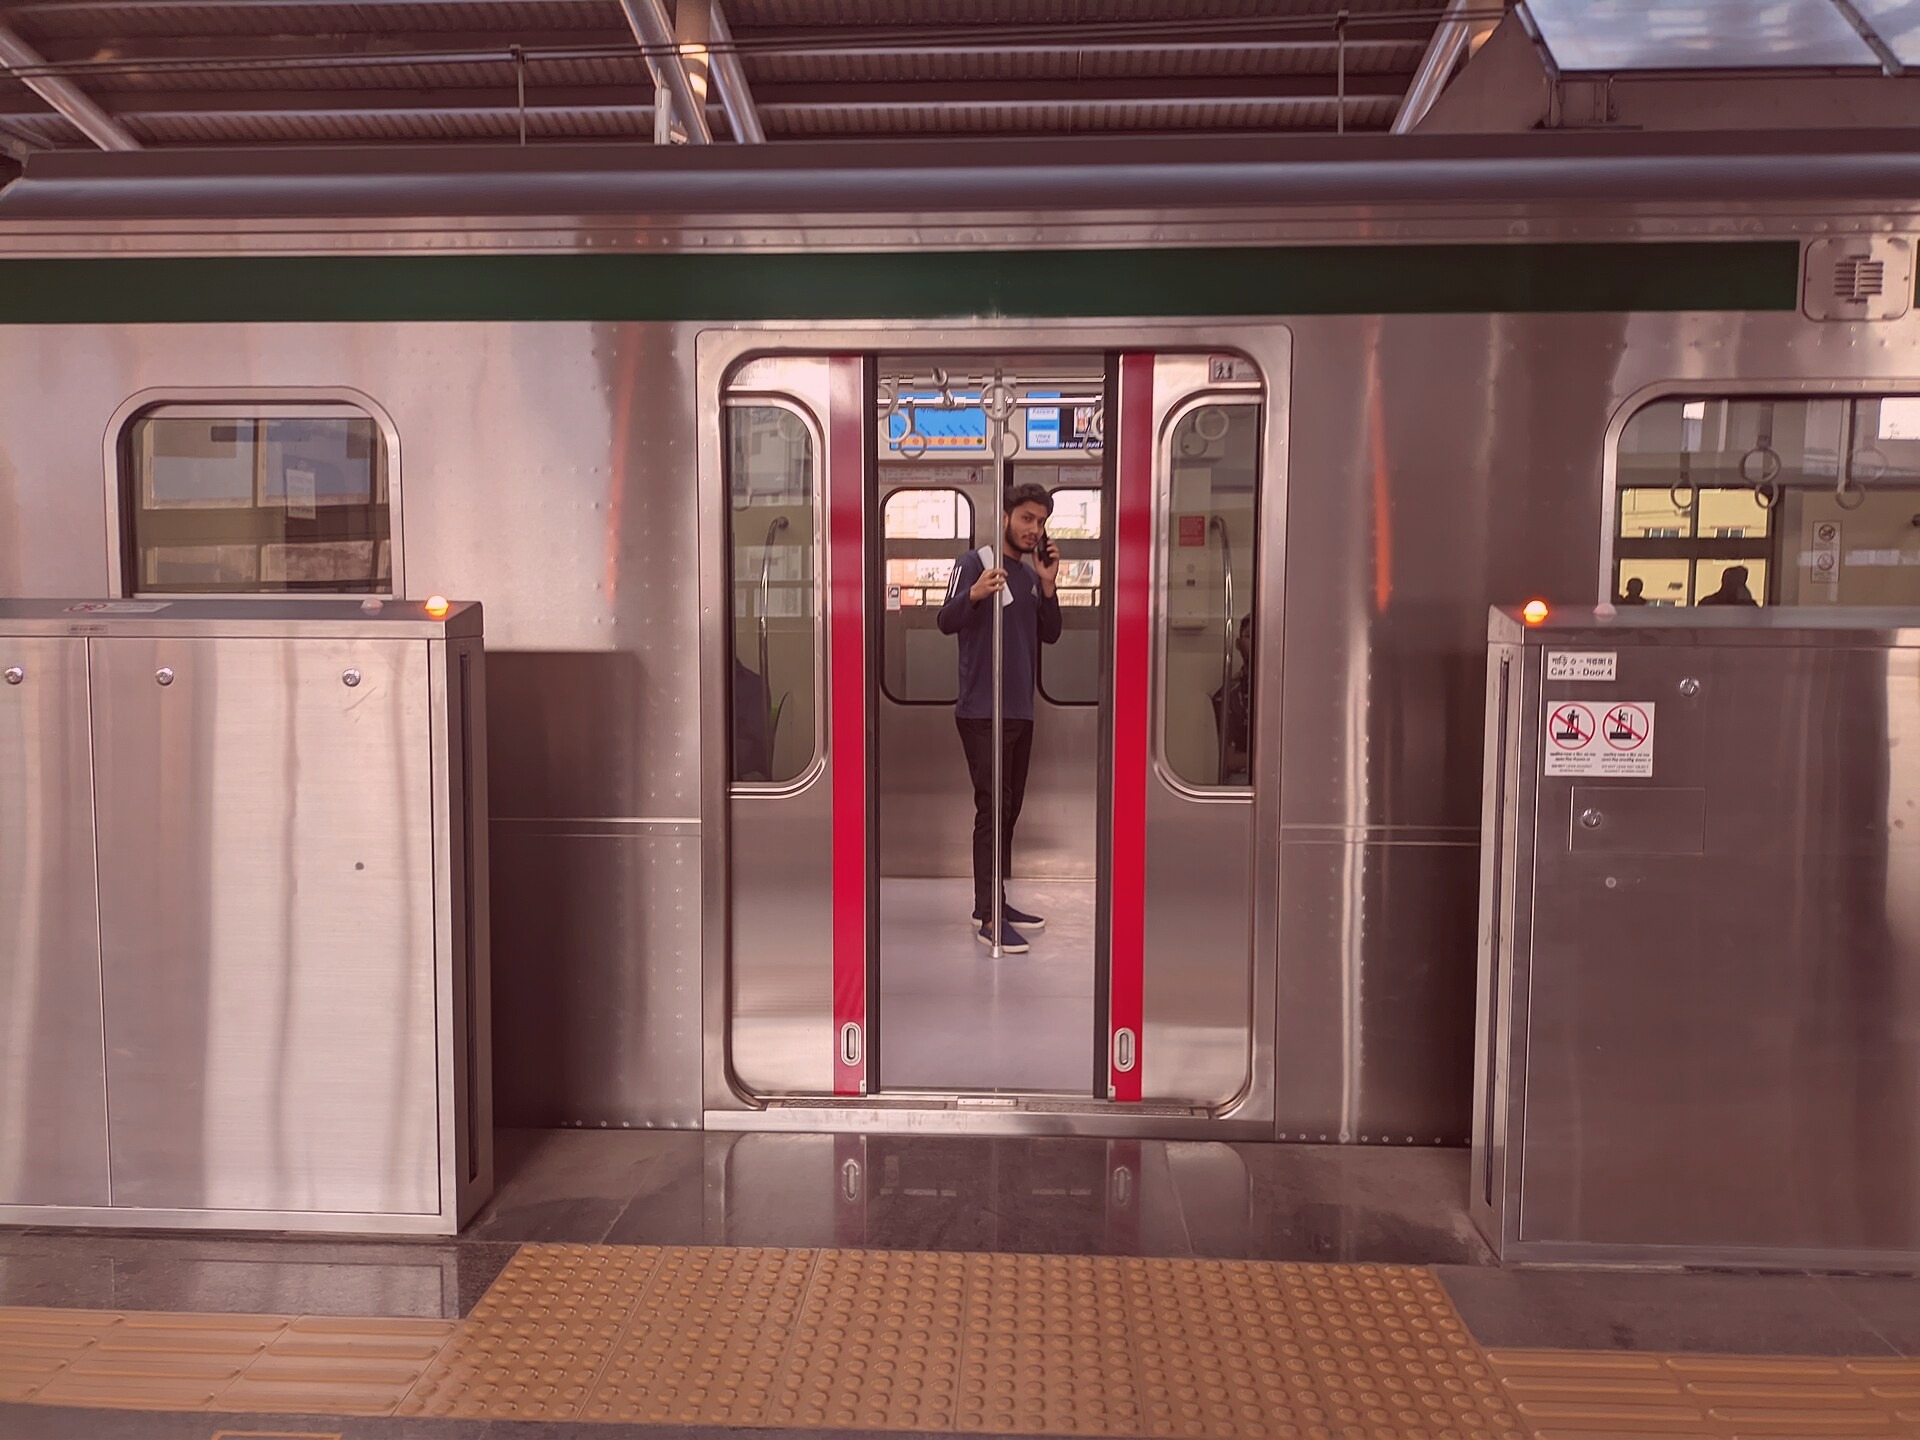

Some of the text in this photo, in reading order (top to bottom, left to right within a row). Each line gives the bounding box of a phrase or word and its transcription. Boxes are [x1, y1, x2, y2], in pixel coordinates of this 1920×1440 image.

[1551, 667, 1566, 675] Car
[1569, 667, 1575, 675] 3
[1583, 668, 1604, 676] Door
[1607, 668, 1612, 676] 4
